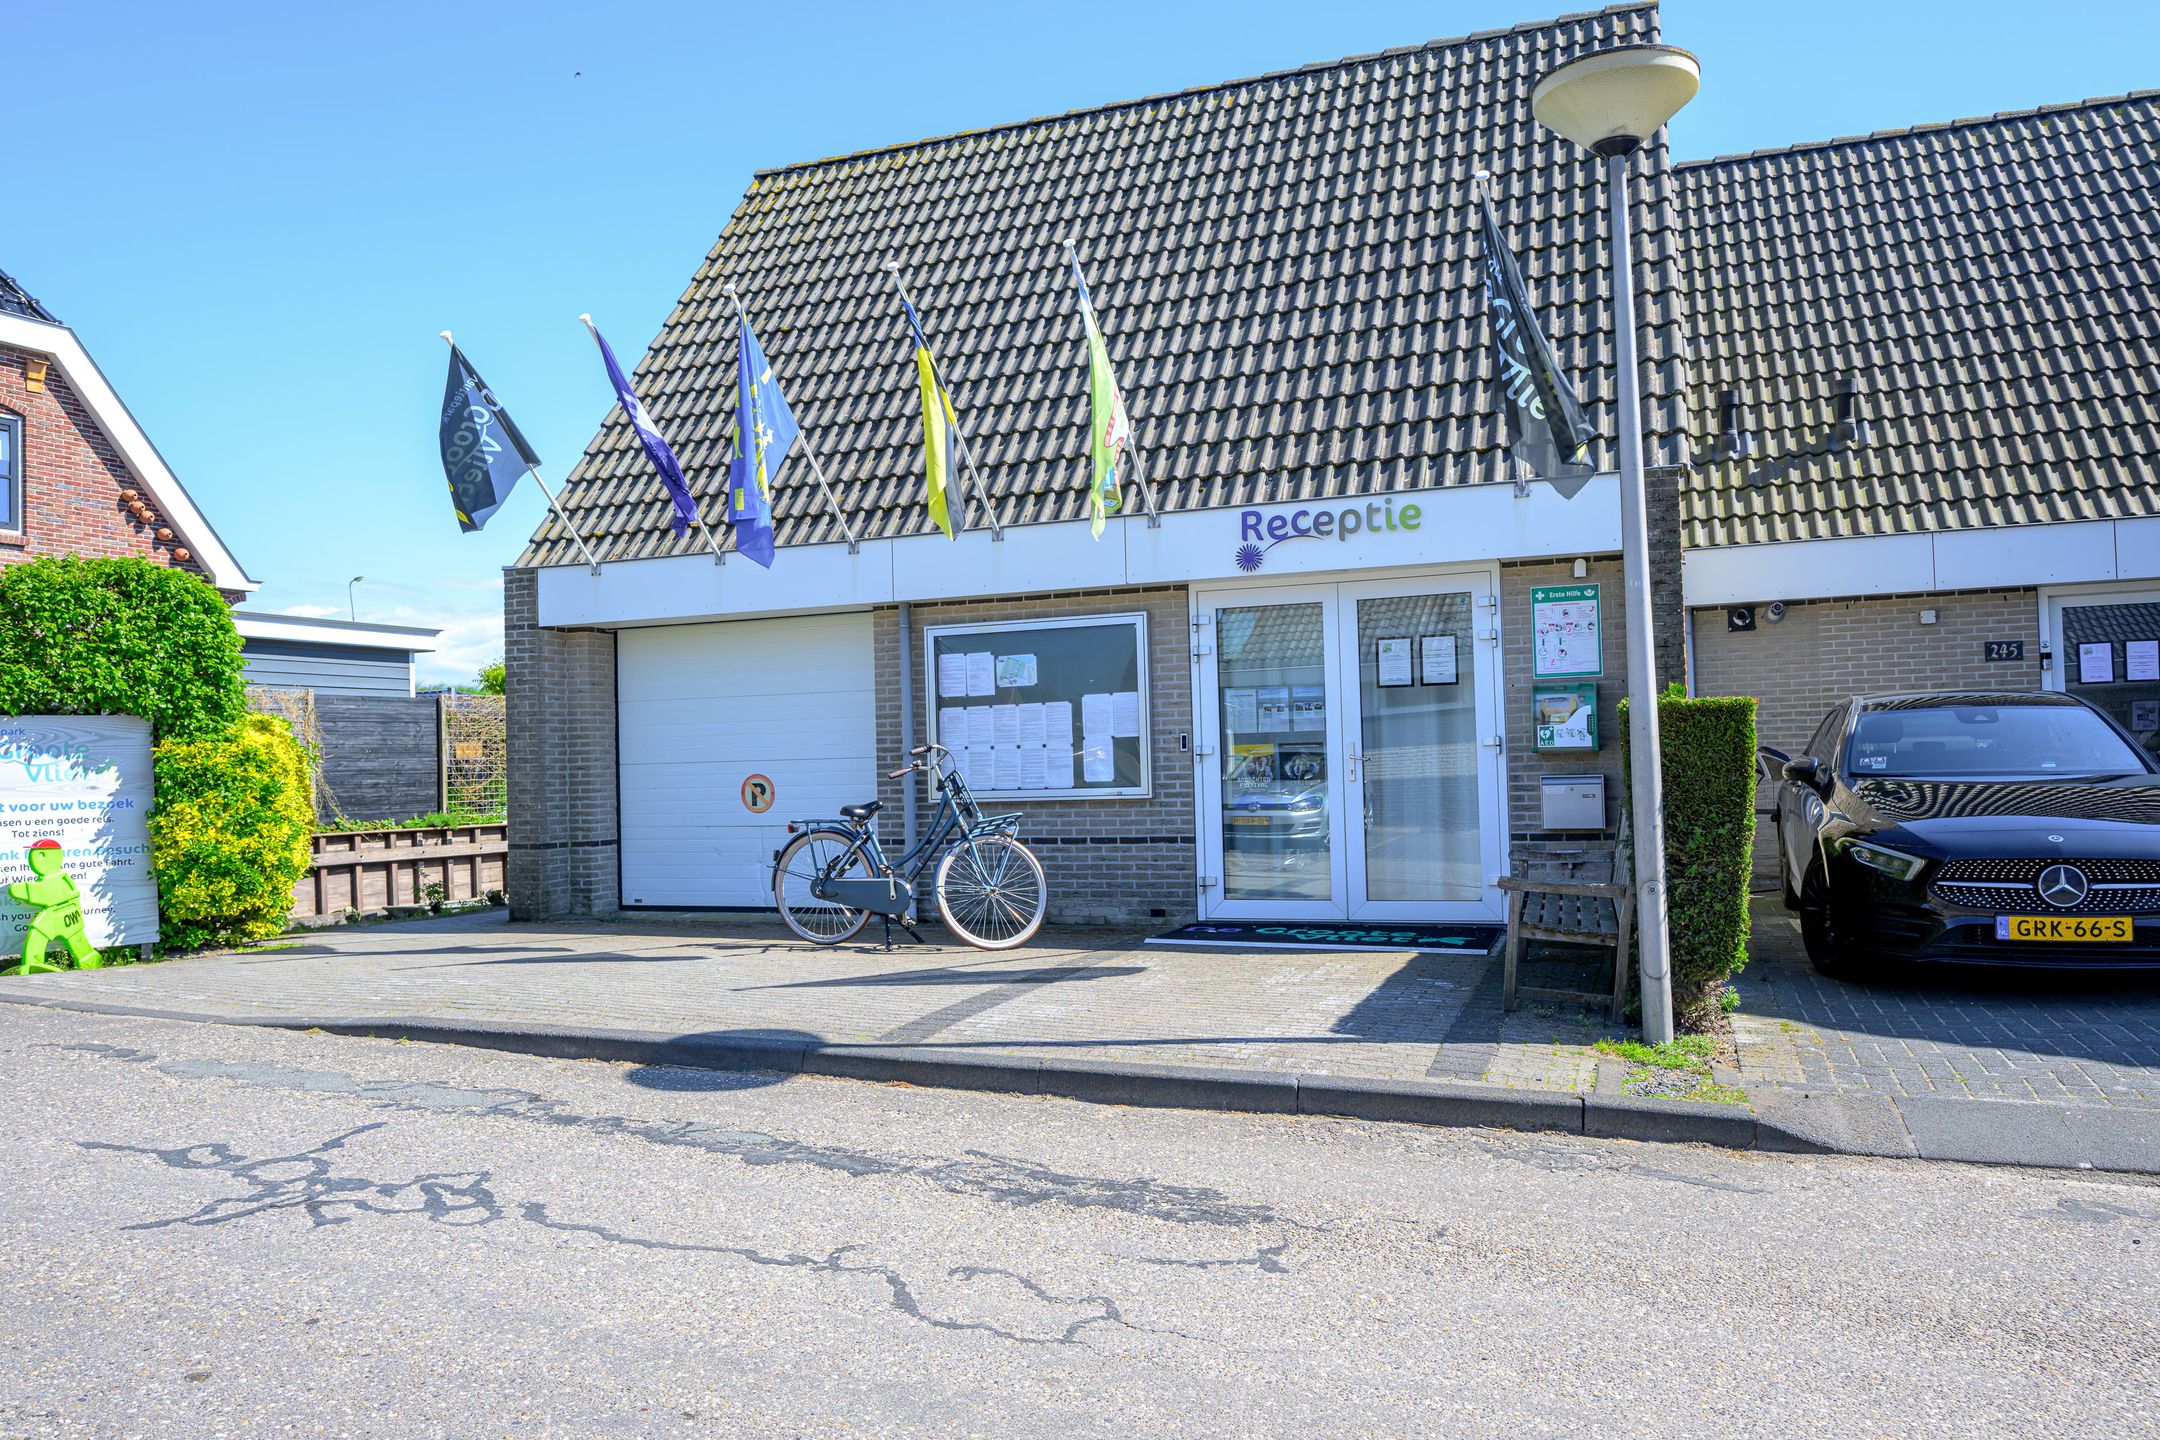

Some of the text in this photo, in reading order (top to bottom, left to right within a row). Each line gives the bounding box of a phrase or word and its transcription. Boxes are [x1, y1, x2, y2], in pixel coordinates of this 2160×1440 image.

[1241, 497, 1422, 542] Receptie
[1990, 643, 2018, 658] 245
[9, 802, 46, 813] voor
[50, 801, 74, 811] uw
[77, 798, 135, 810] bezoek
[34, 818, 54, 826] een
[56, 816, 90, 828] goede
[11, 829, 65, 838] Tot ziens!
[79, 859, 103, 871] gute
[11, 913, 31, 922] you
[1255, 927, 1417, 937] Groote
[2017, 919, 2126, 938] GRK-66-S
